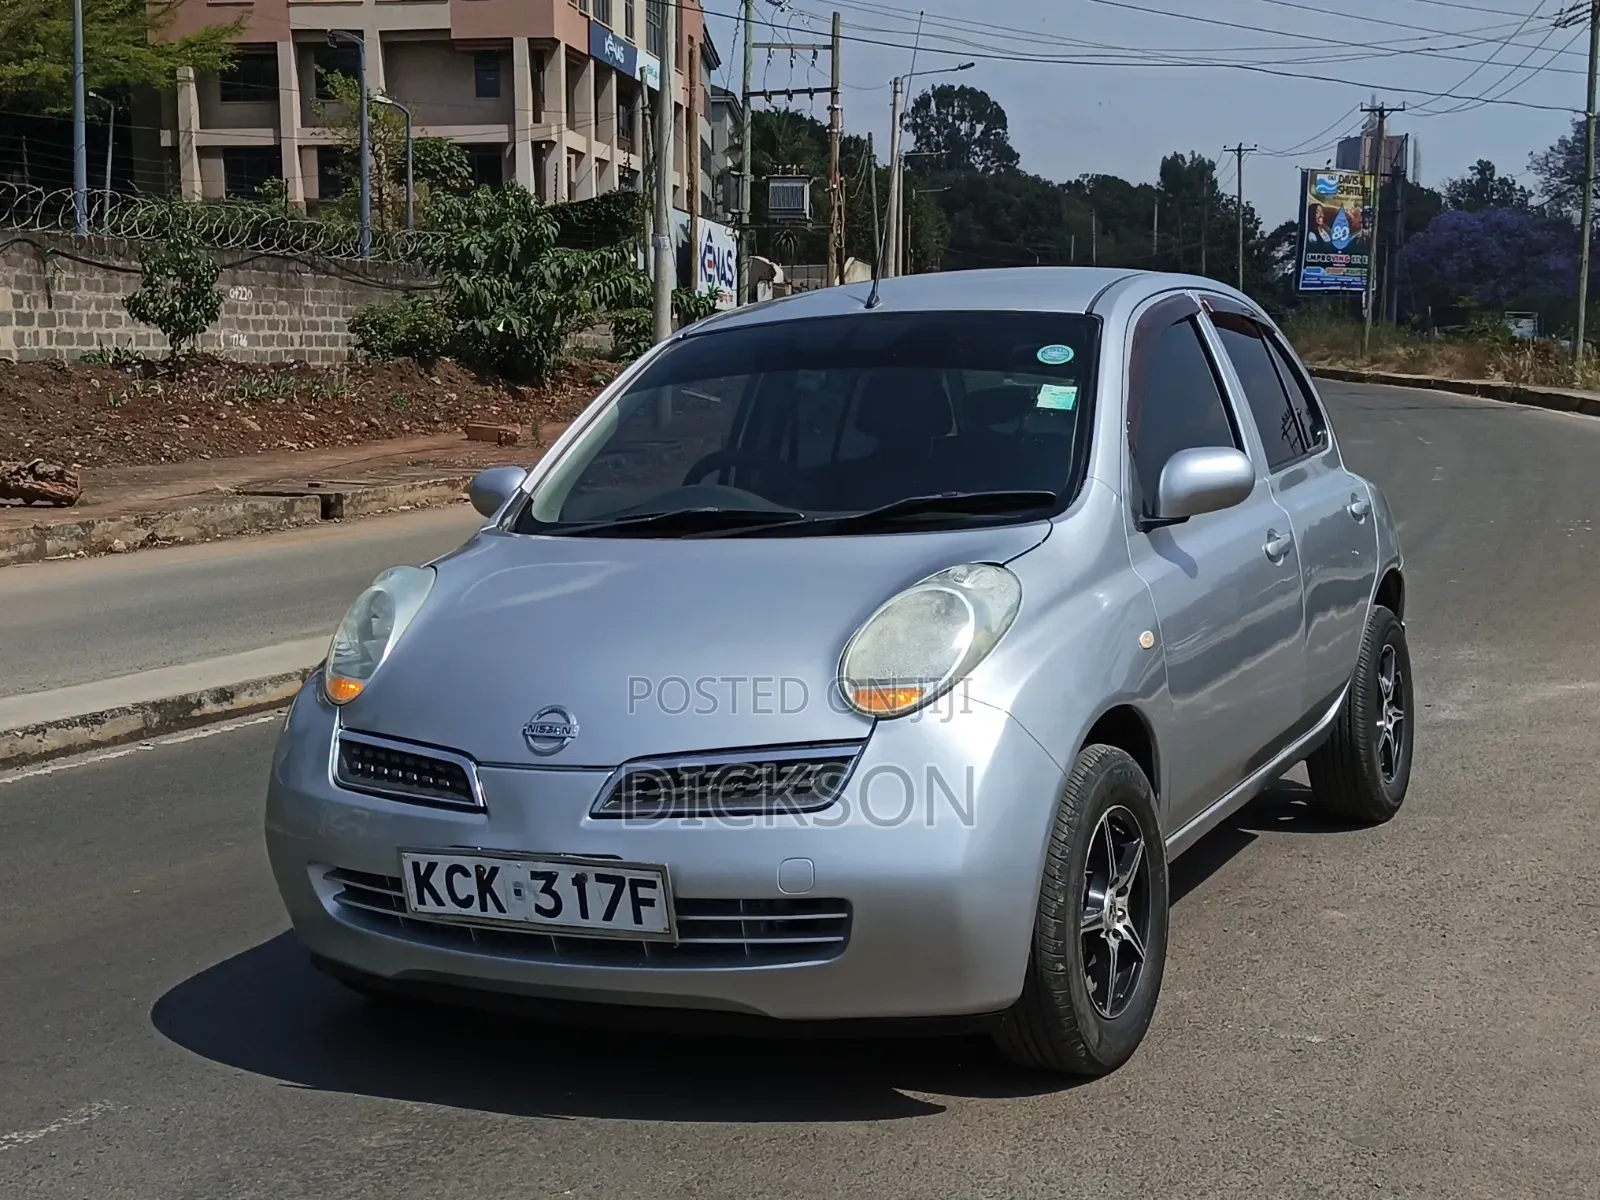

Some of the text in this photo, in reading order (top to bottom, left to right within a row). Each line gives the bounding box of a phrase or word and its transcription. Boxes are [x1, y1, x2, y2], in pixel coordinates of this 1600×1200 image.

[1338, 174, 1359, 186] DAVIS
[1331, 225, 1350, 241] 80
[1306, 253, 1351, 264] IMPROVING
[527, 724, 572, 735] NISSAN
[411, 861, 658, 926] KCK 317F
